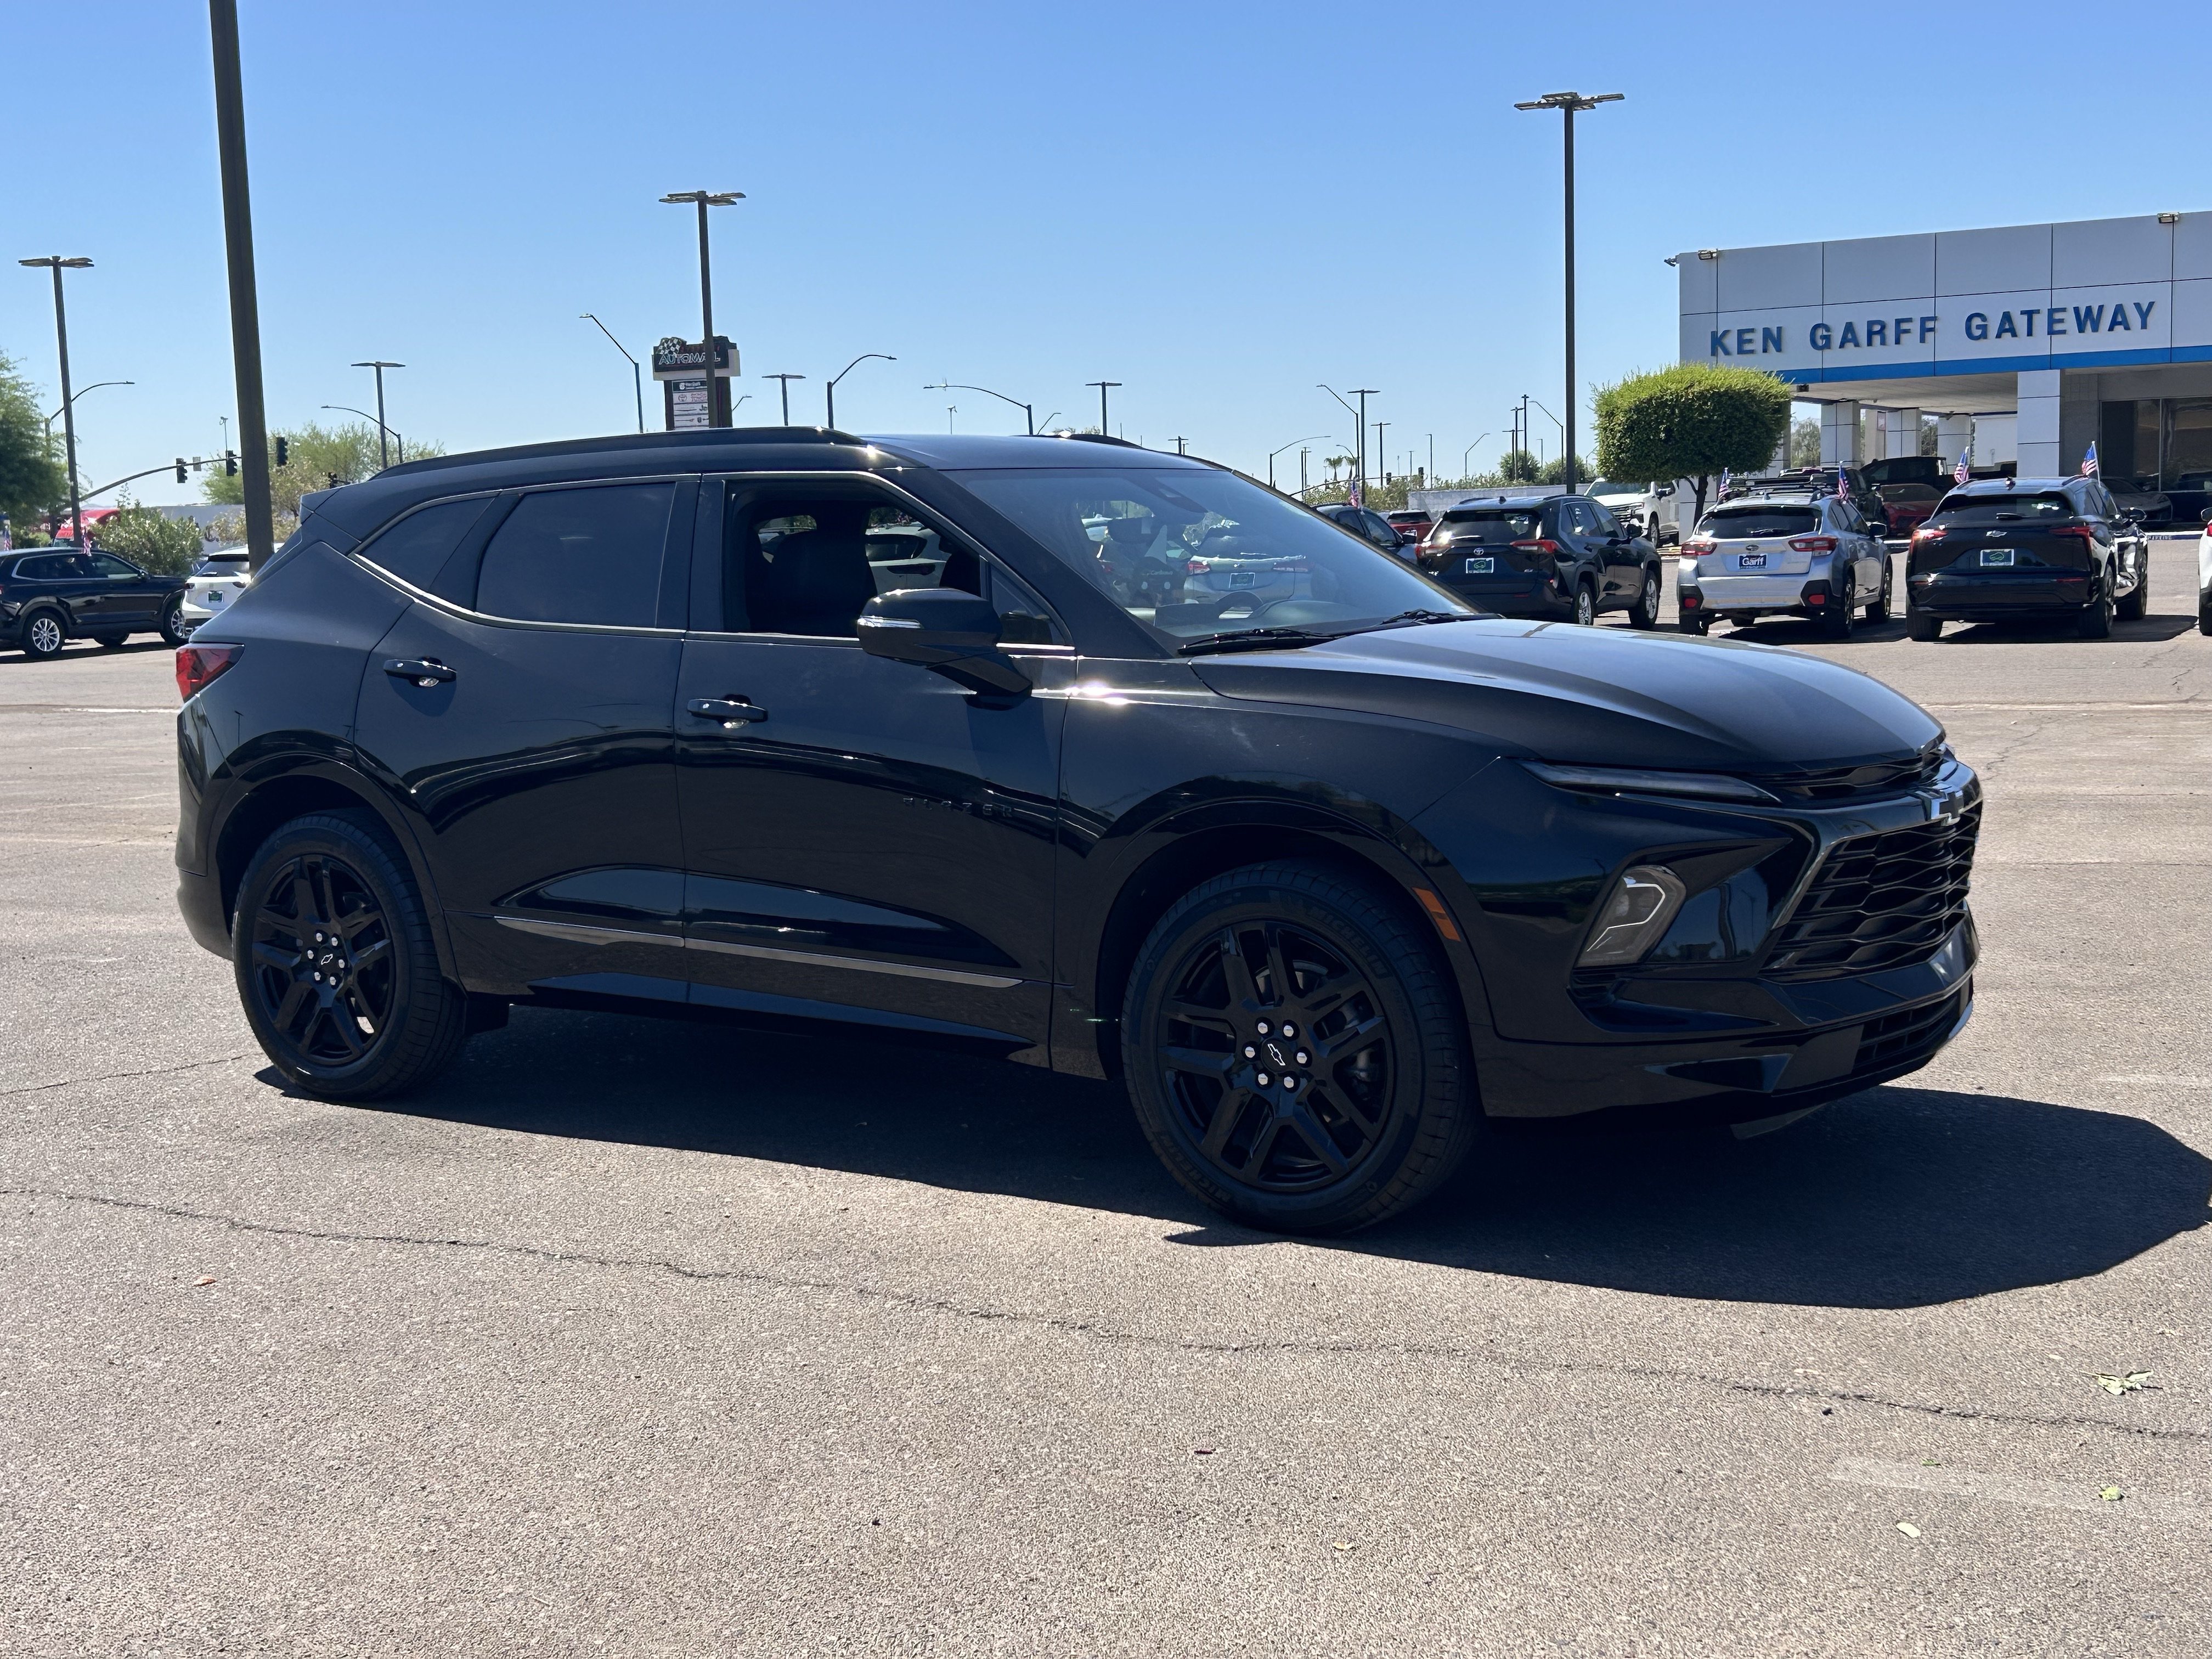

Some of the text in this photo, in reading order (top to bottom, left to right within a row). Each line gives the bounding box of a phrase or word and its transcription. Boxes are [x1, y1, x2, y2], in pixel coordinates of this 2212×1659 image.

[1711, 302, 2155, 357] KEN GARFF GATEWAY
[658, 352, 721, 365] AUTOMAL
[902, 797, 1013, 818] ZER
